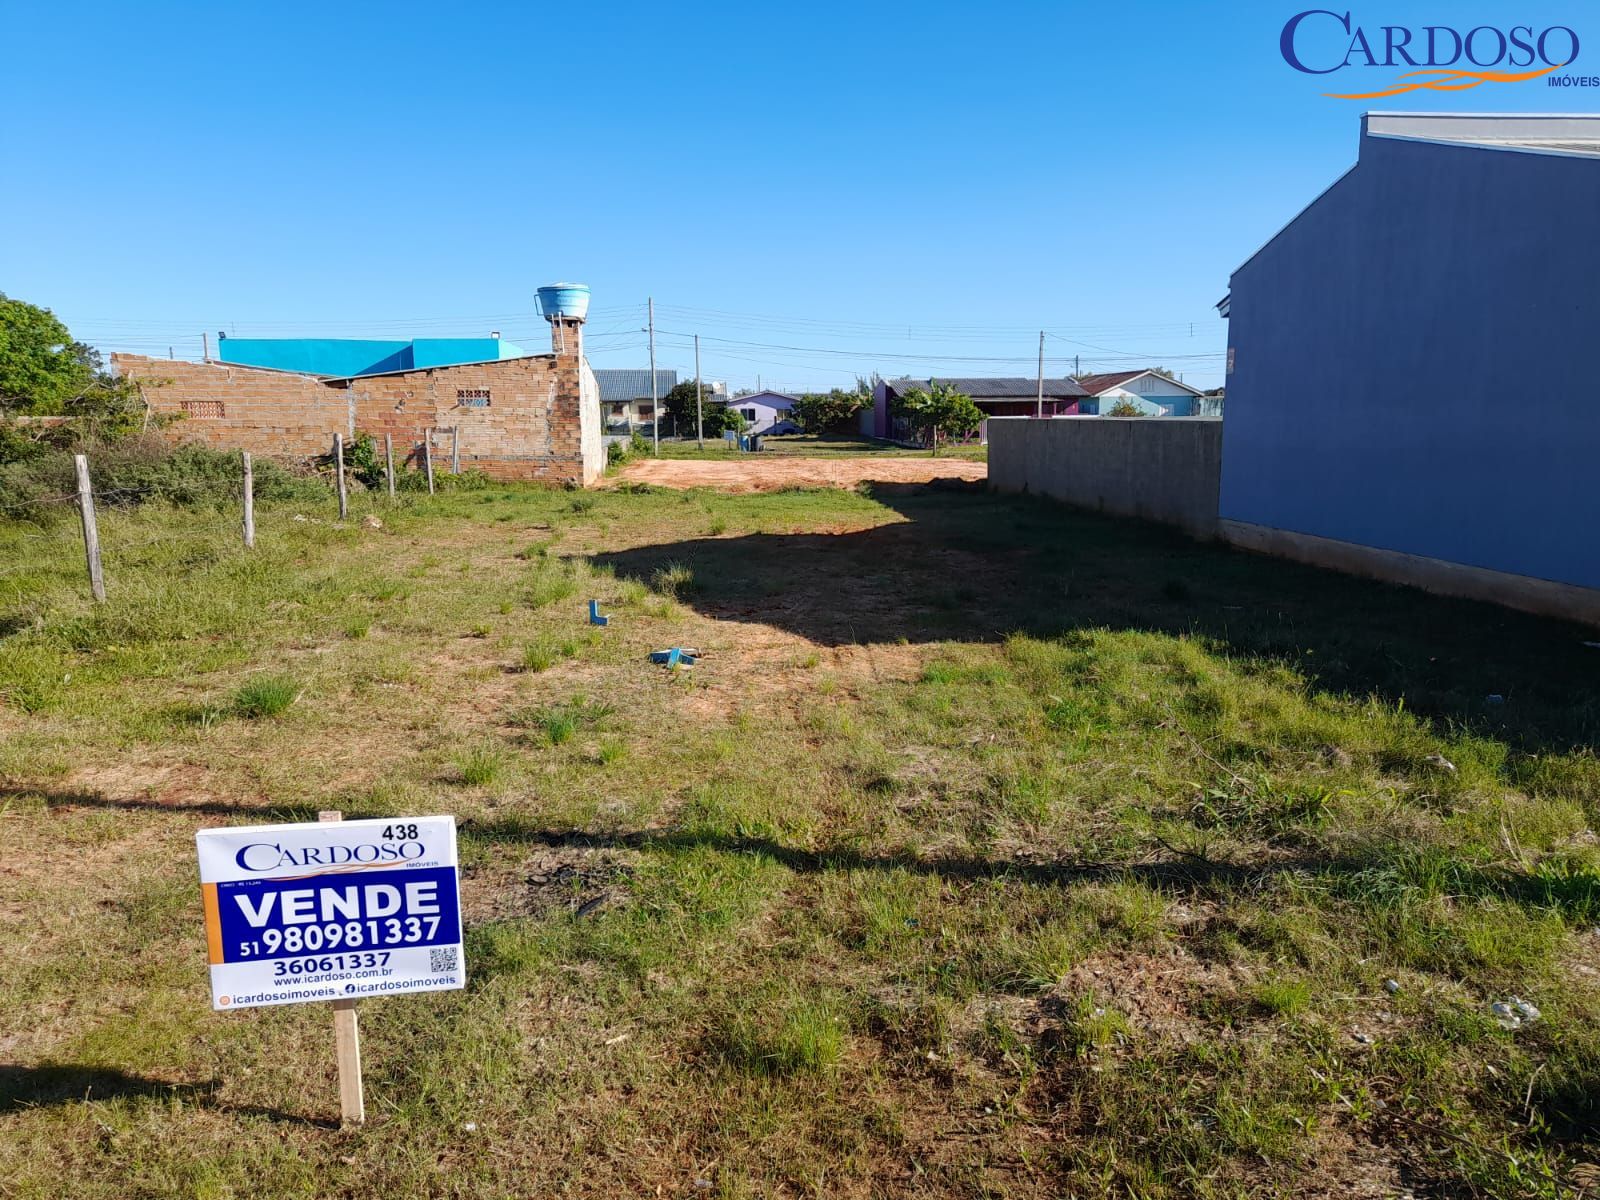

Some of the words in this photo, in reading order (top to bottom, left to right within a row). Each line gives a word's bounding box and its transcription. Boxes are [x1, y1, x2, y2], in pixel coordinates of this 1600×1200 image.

[382, 824, 419, 840] 438
[235, 842, 425, 871] CARDOSO
[233, 881, 441, 928] VENDE
[240, 941, 260, 956] 51
[262, 916, 441, 954] 980981337
[274, 952, 391, 976] 36061337
[274, 967, 393, 987] www.icardoso.com.br
[233, 986, 336, 1004] icardosoimoveis
[357, 975, 456, 993] icardosoimoveis
